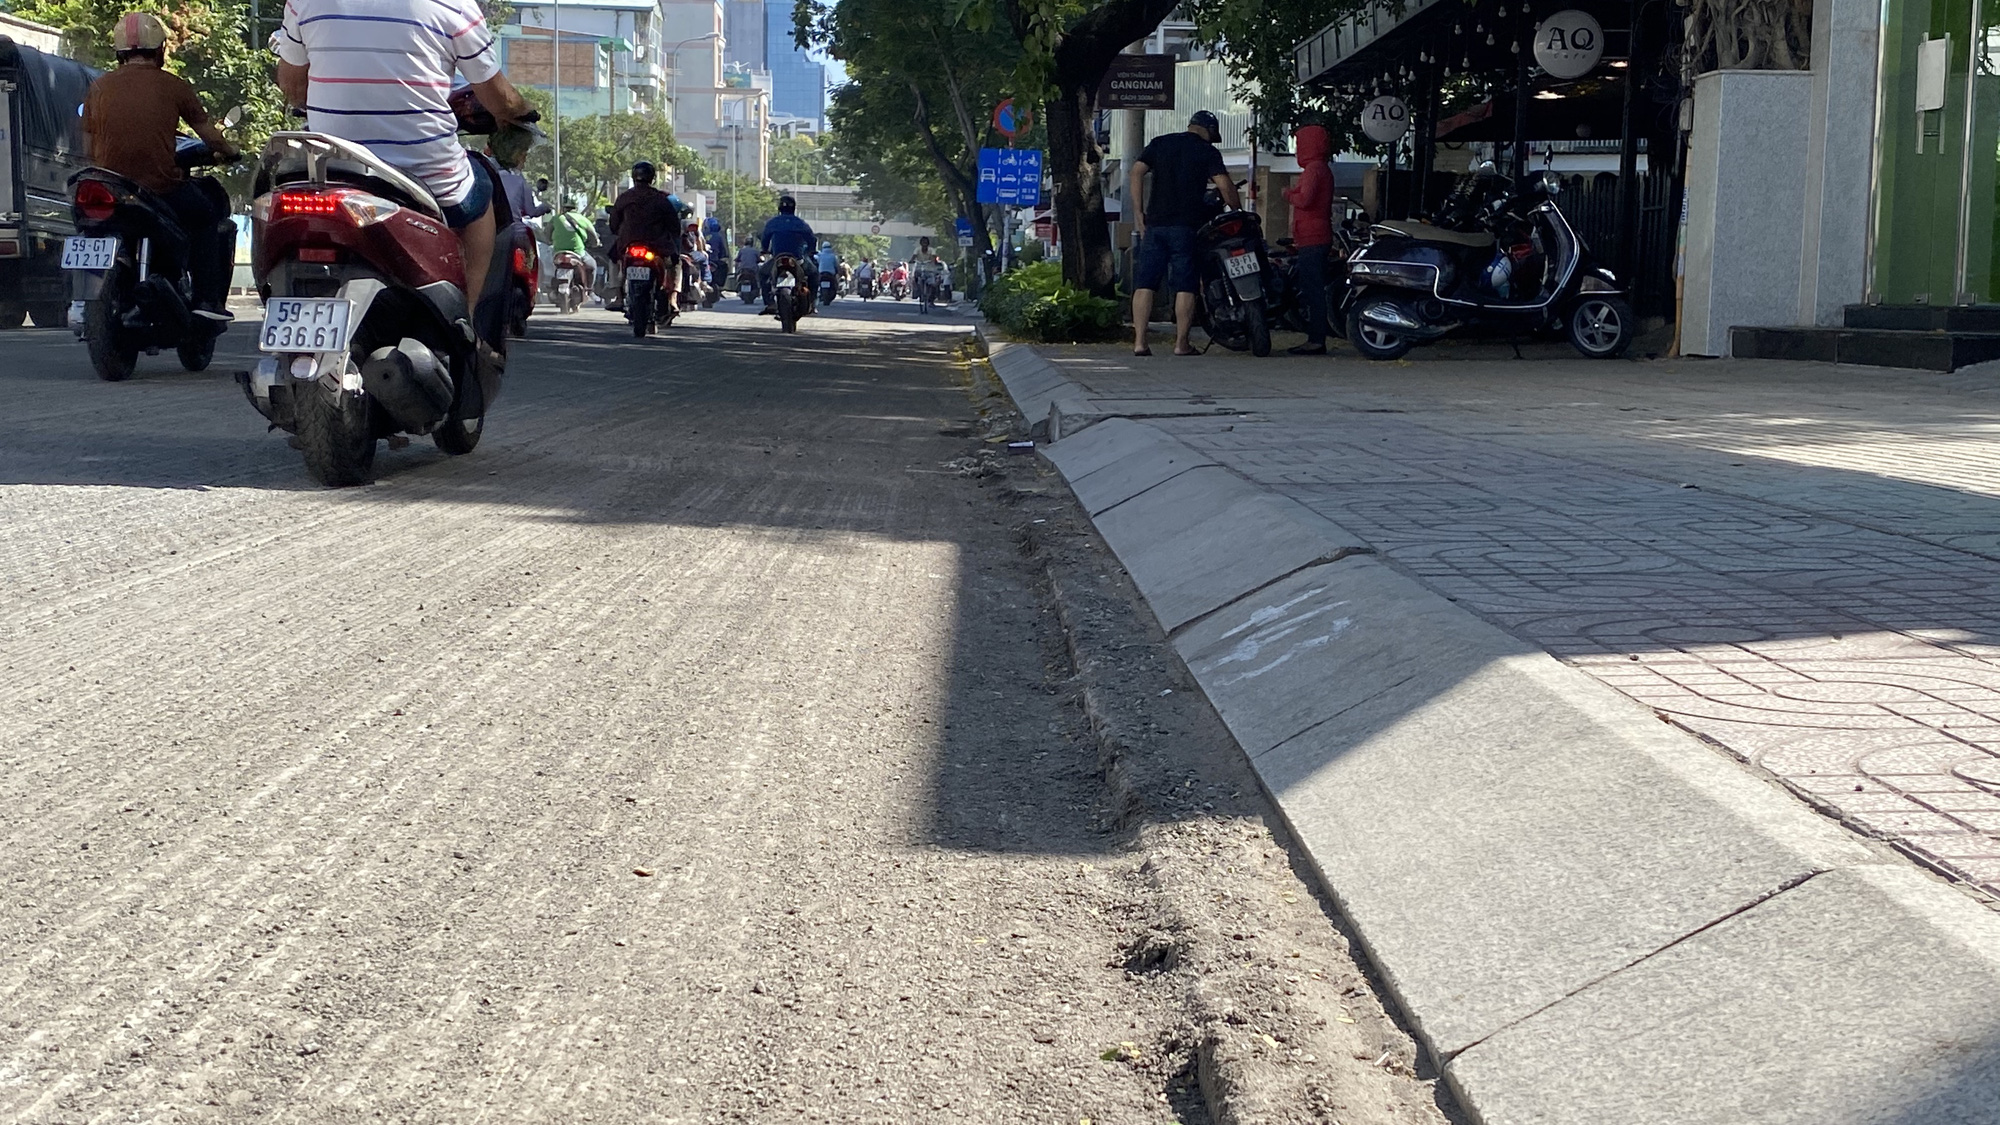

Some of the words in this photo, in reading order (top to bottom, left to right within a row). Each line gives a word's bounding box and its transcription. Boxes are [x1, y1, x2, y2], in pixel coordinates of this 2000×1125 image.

[1546, 27, 1594, 50] AQ
[1110, 80, 1164, 90] GANGNAM
[1372, 104, 1405, 122] AQ
[71, 239, 106, 252] 59-G1
[277, 302, 335, 324] 59-F1
[266, 325, 339, 349] 636.61
